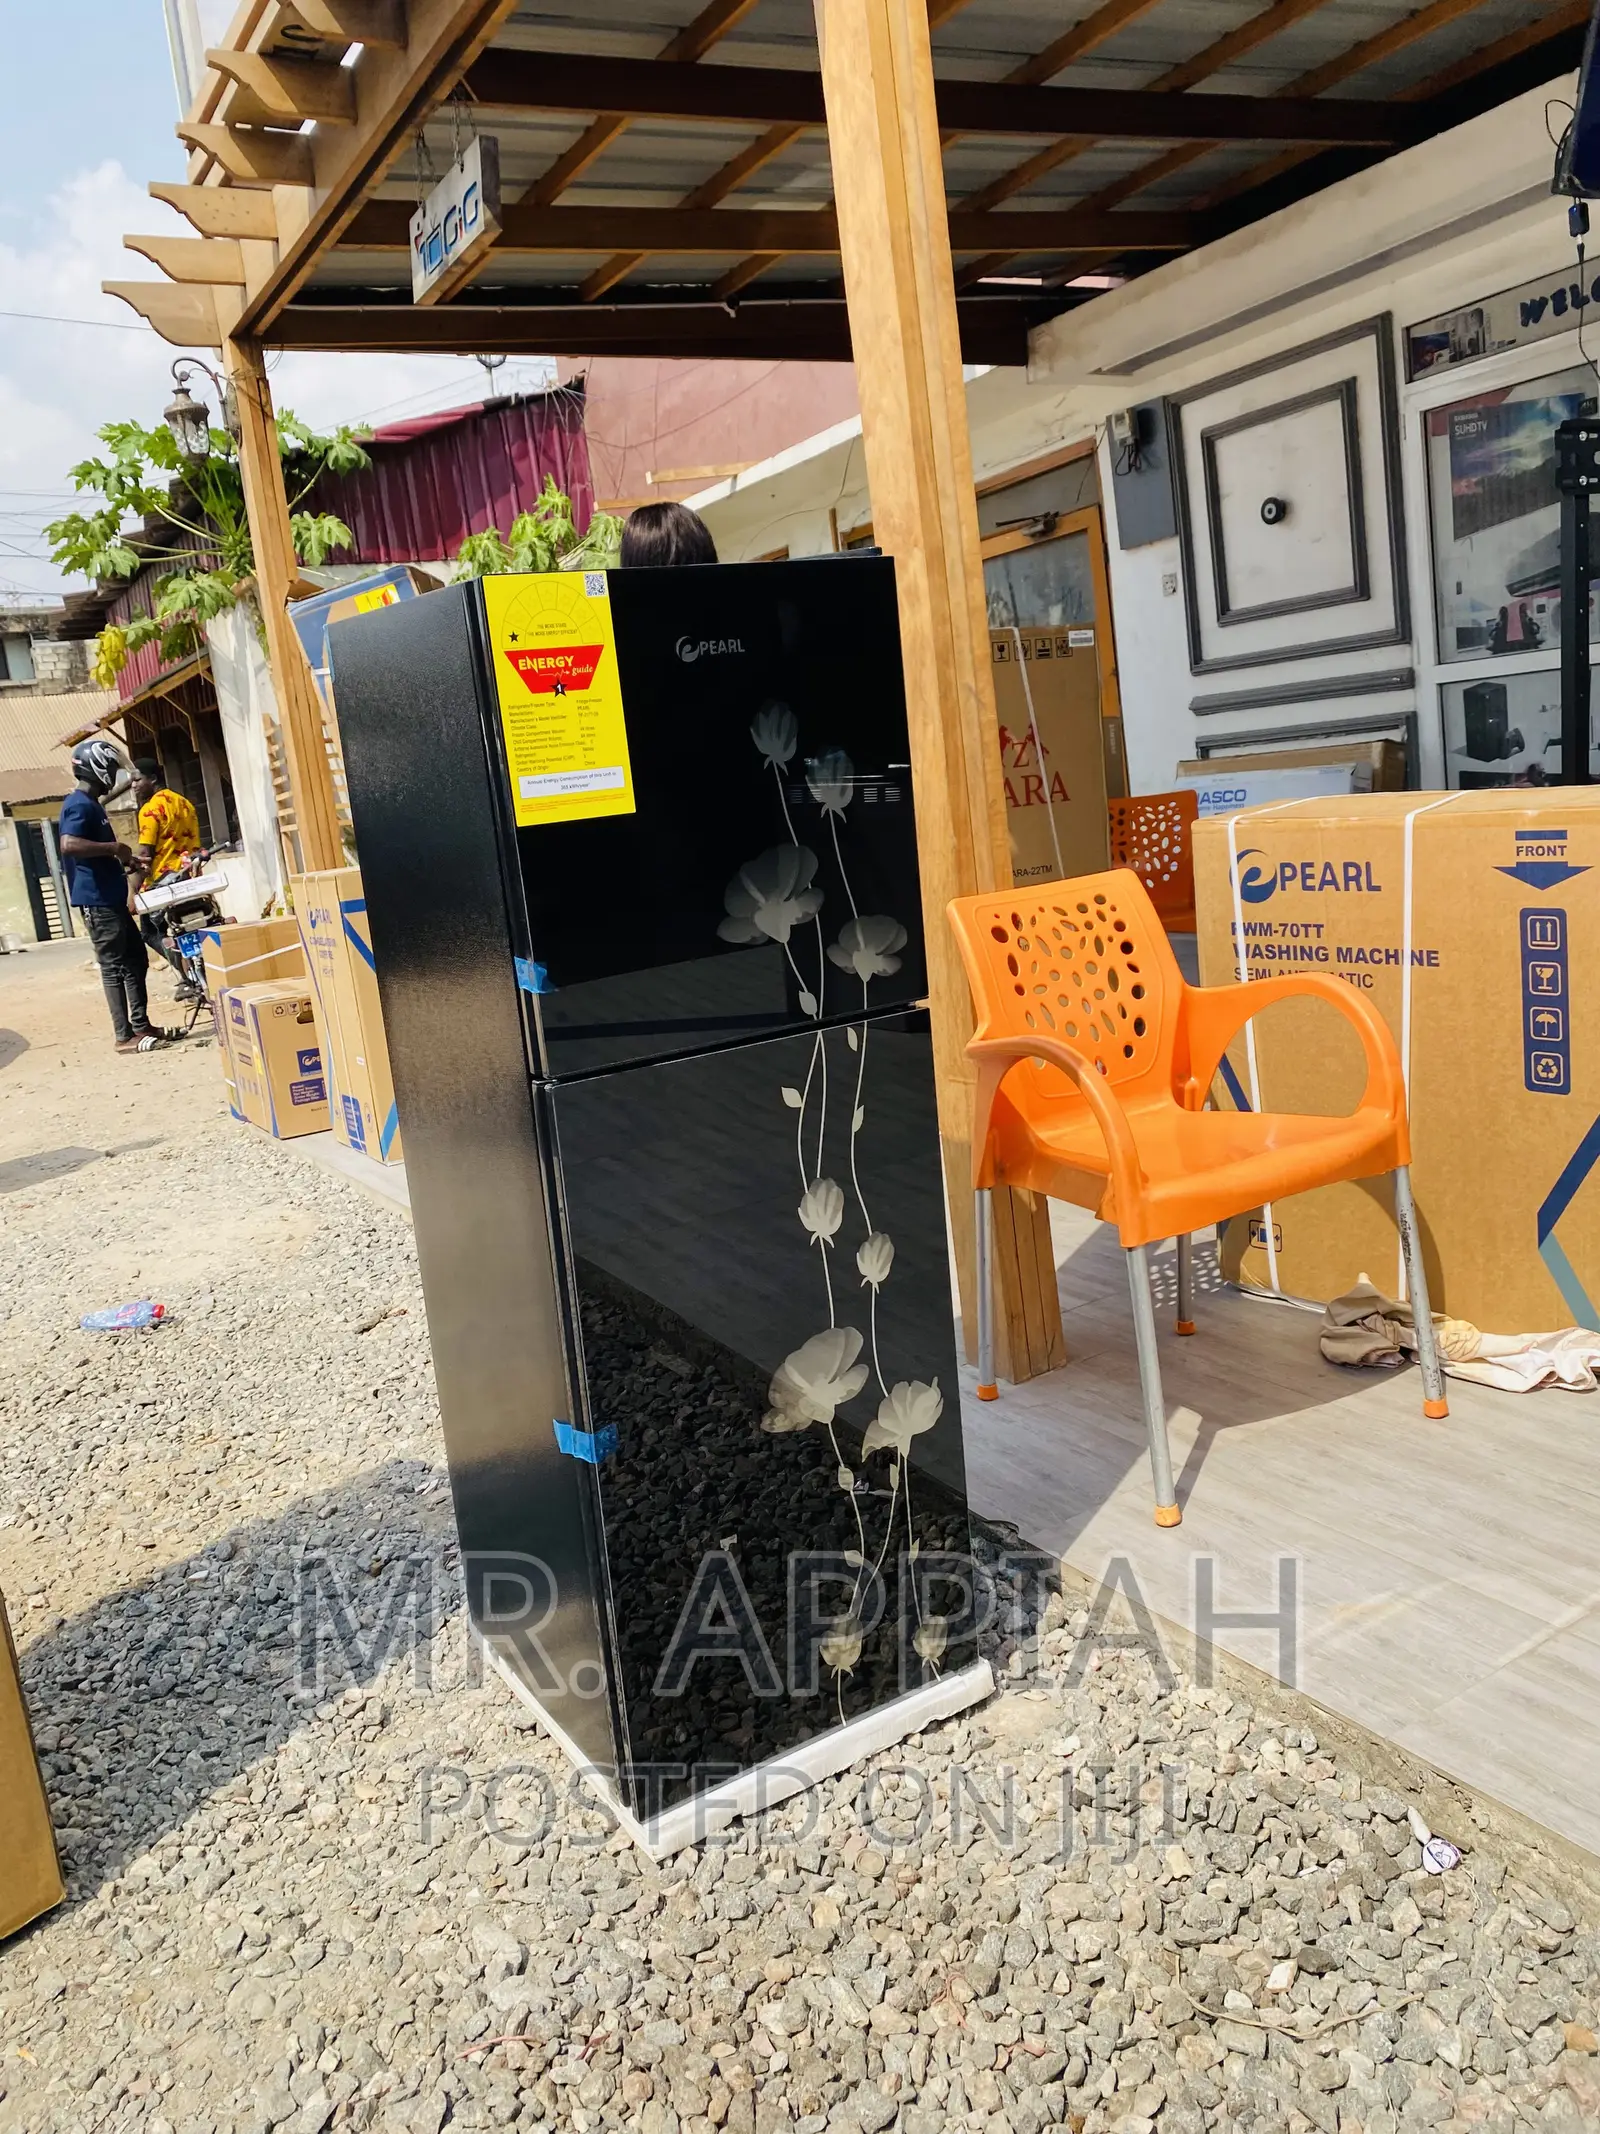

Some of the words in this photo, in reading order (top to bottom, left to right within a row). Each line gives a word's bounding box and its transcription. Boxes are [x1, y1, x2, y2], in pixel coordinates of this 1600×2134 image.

[699, 639, 746, 655] PEARL
[518, 656, 574, 675] ENERGY
[571, 664, 593, 677] guide
[556, 683, 562, 693] 1
[1198, 788, 1248, 805] ASCO
[1516, 845, 1567, 857] FRONT
[1279, 861, 1382, 892] PEARL
[1232, 943, 1330, 962] WASHING
